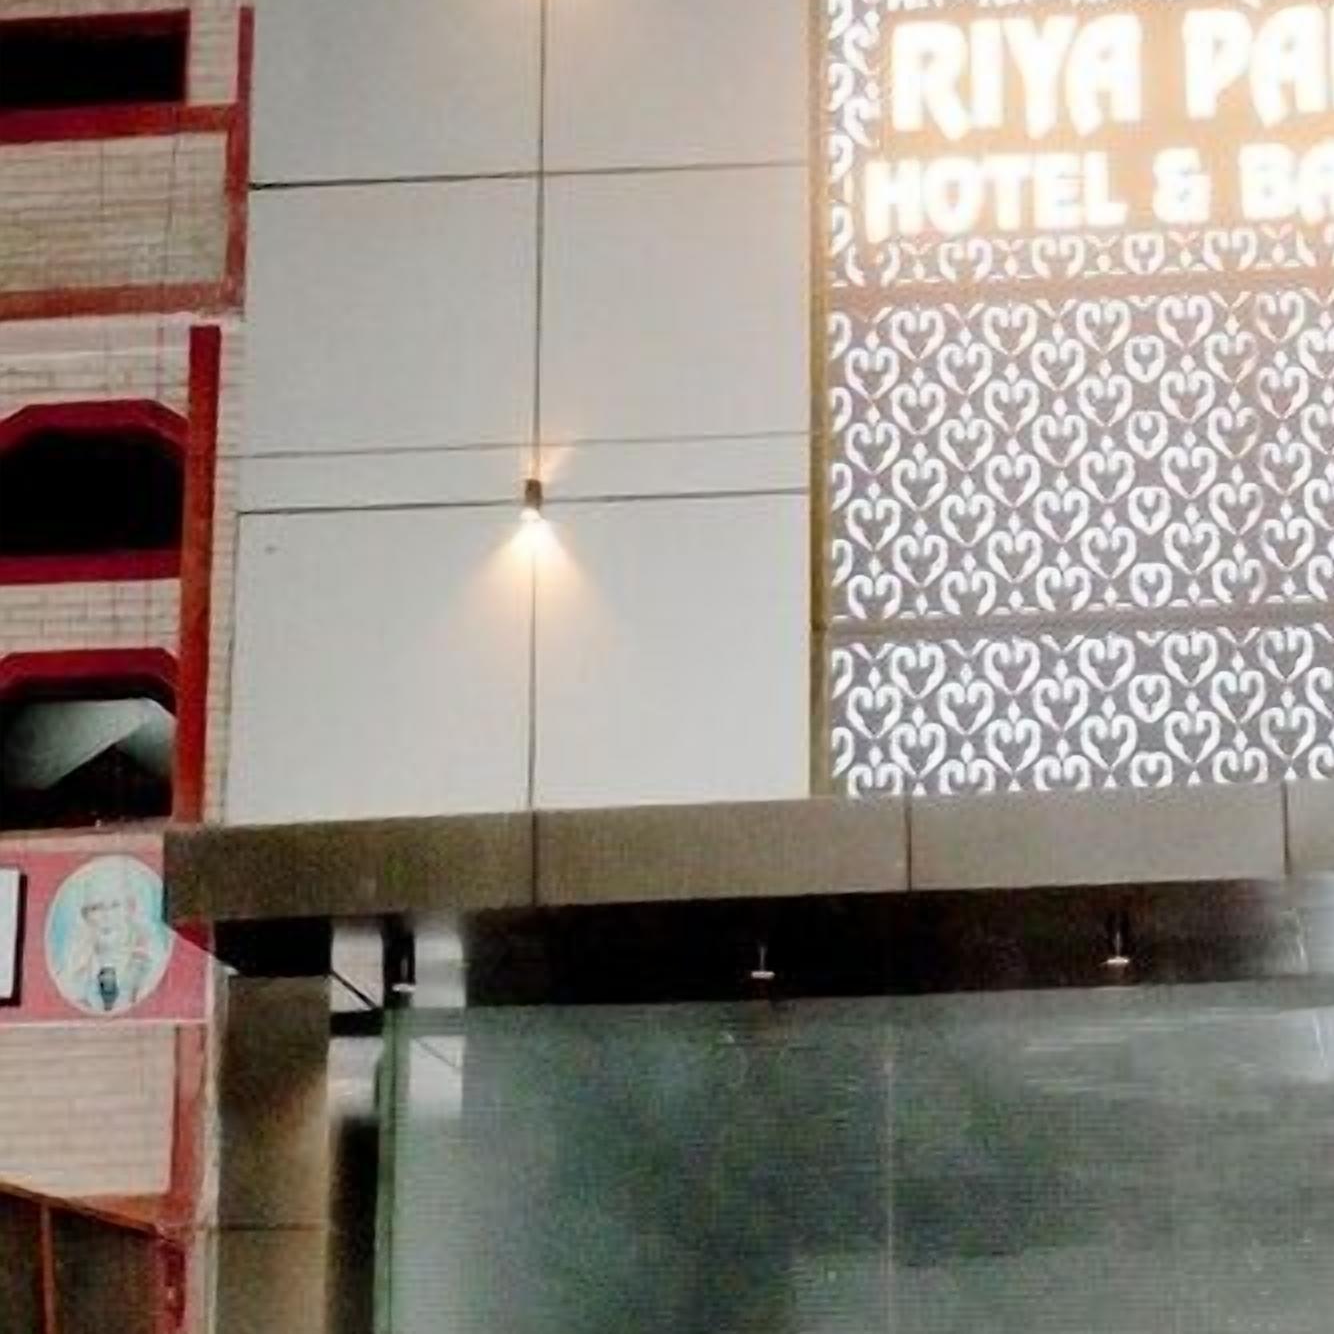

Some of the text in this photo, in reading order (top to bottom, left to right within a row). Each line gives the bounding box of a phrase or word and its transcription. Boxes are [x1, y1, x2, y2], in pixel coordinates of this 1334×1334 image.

[889, 10, 1143, 139] RIYA
[863, 151, 1128, 244] HOTEL
[1151, 147, 1212, 224] &
